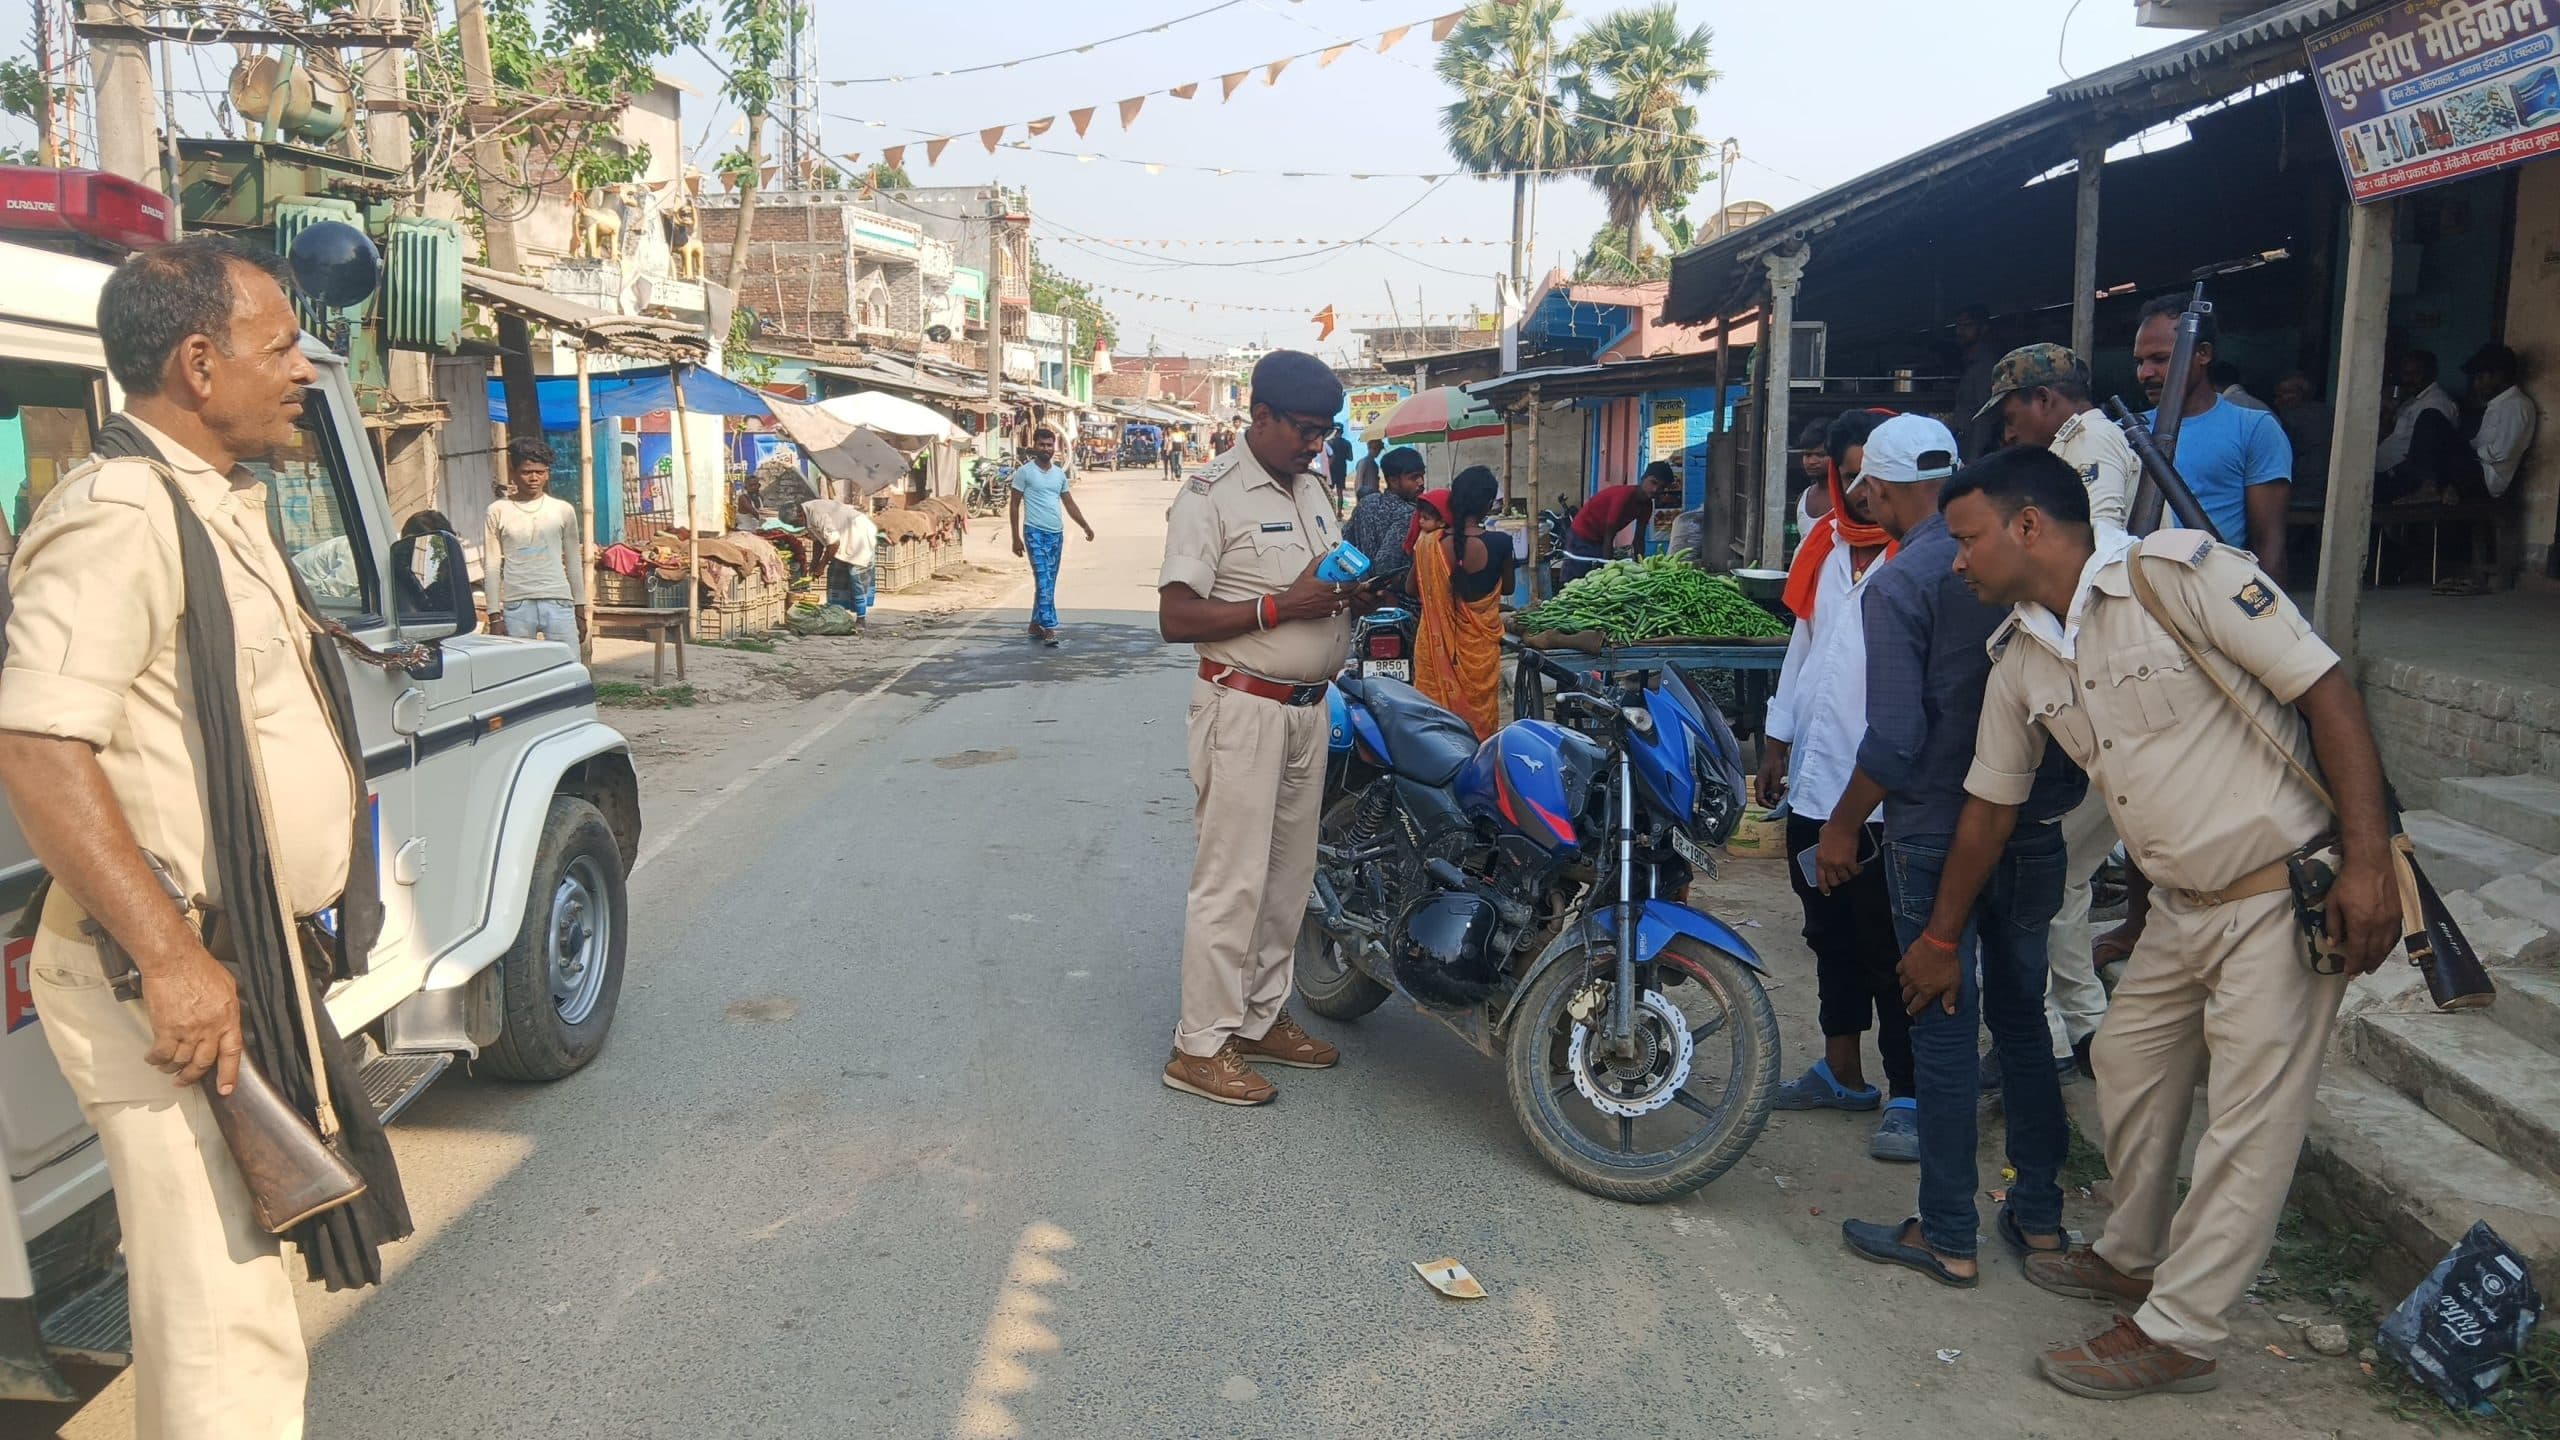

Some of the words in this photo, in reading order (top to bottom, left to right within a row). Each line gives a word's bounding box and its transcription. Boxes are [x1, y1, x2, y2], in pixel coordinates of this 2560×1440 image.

[2320, 32, 2421, 109] कुलदीप
[2418, 0, 2548, 60] मेडिकल
[6, 199, 57, 212] DURATONE
